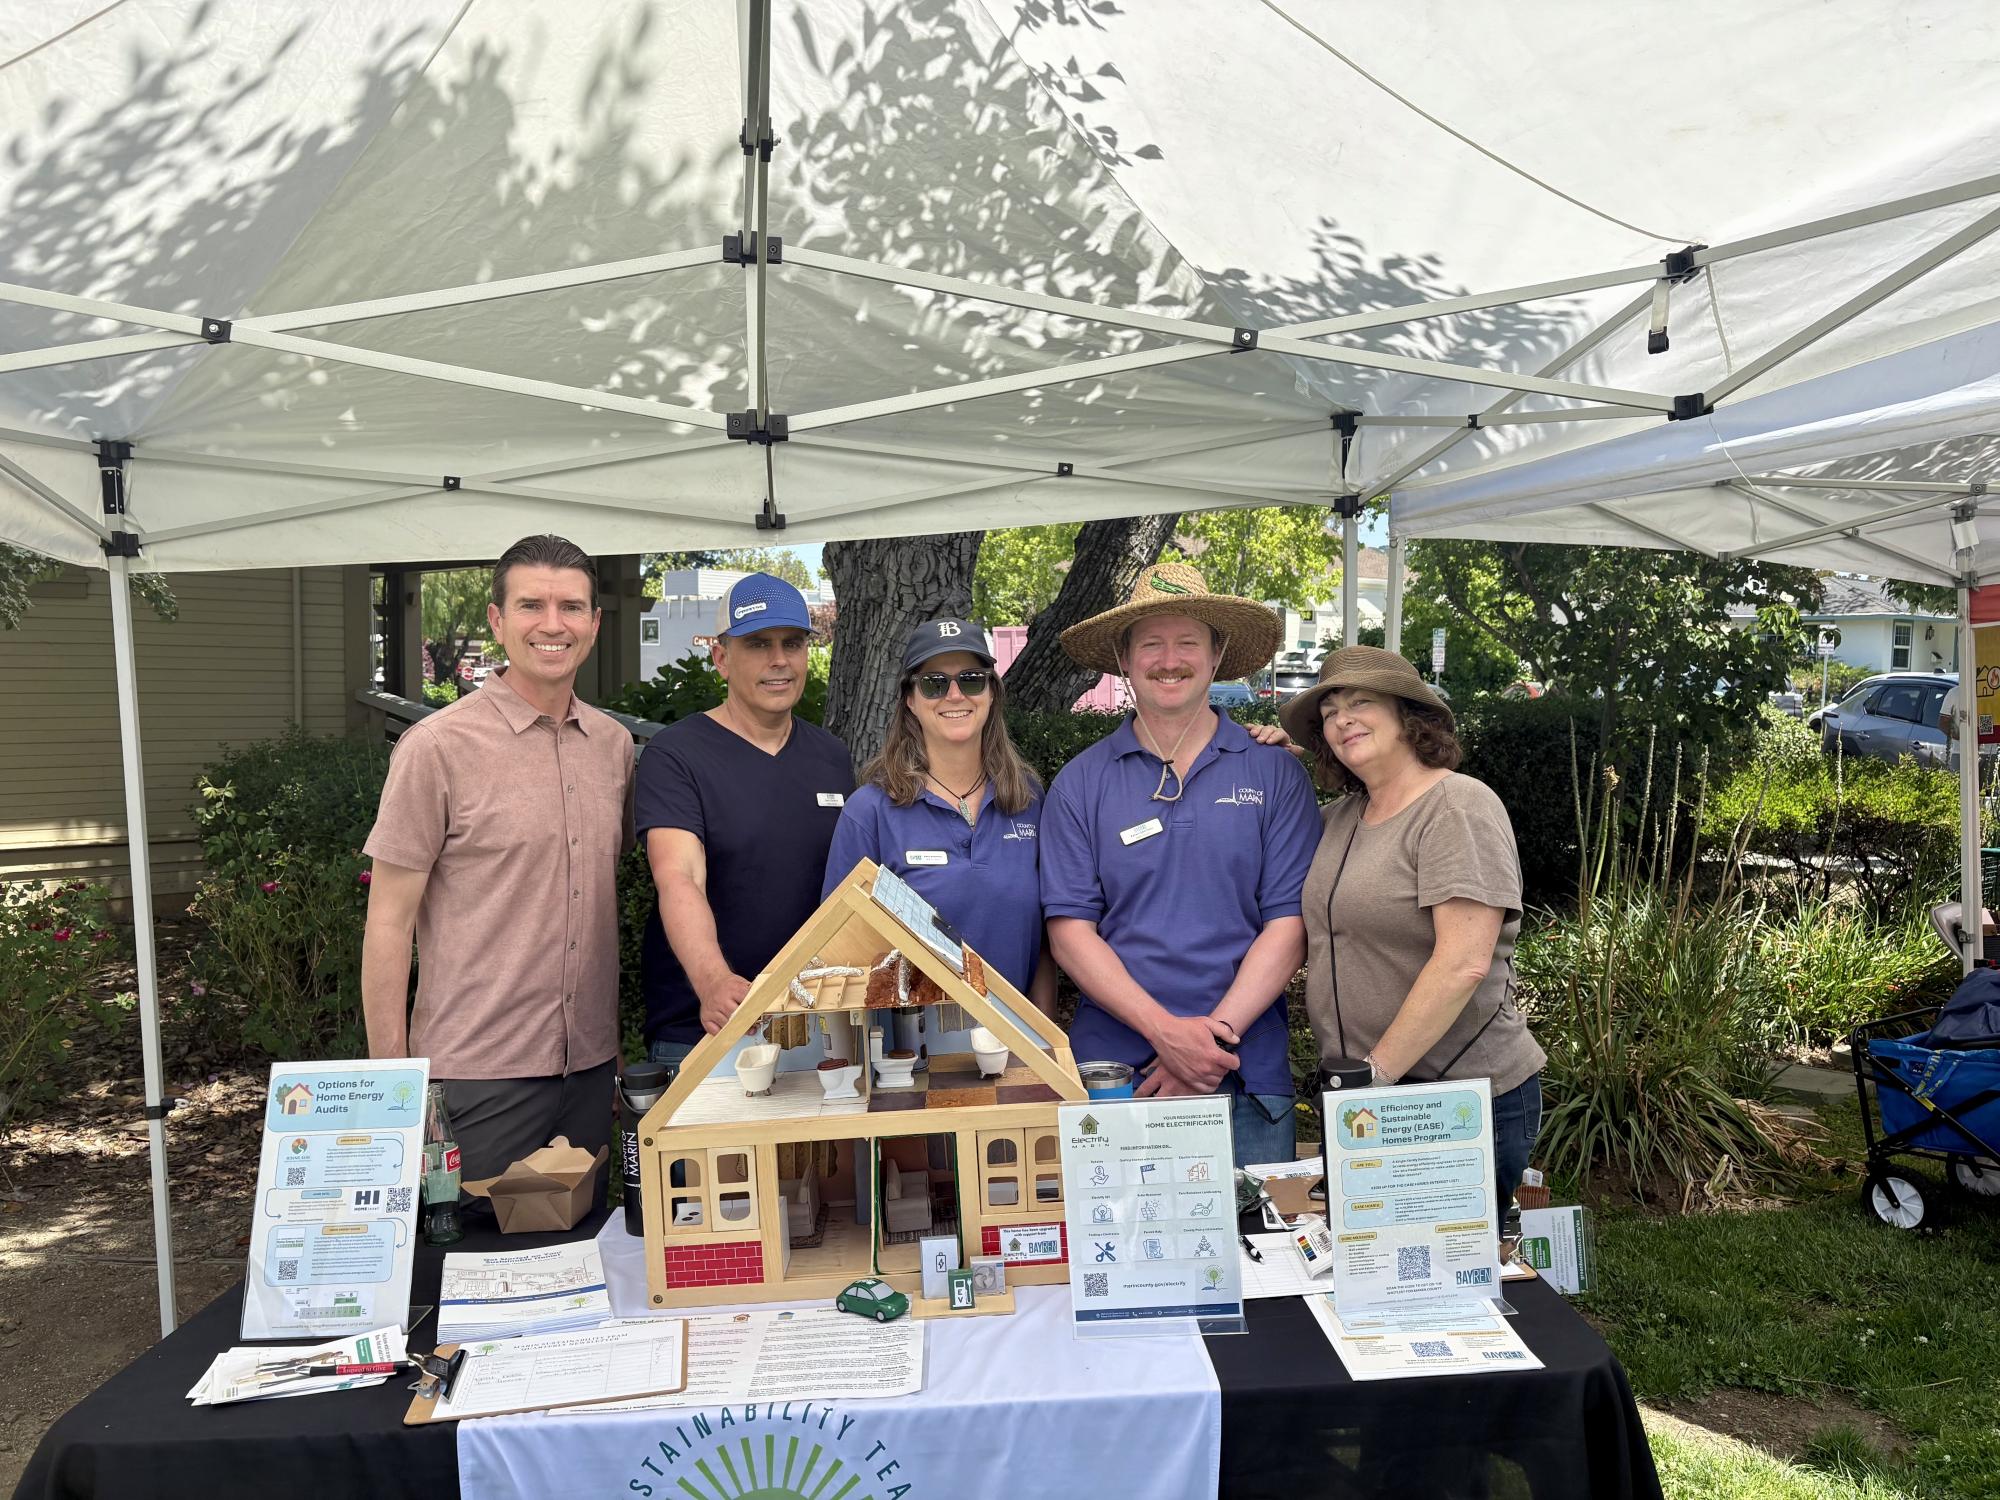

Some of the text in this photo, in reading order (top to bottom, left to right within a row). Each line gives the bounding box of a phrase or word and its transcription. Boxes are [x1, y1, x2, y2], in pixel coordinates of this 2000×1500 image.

[937, 621, 961, 638] B
[317, 1079, 375, 1091] Options for
[316, 1092, 384, 1102] Home Energy
[315, 1105, 348, 1114] Audits
[1380, 1101, 1442, 1113] Efficiency and
[1145, 1119, 1224, 1129] HOME ELECTRIFICATION
[1381, 1113, 1431, 1123] Sustainable
[1381, 1121, 1444, 1134] Energy (EASE)
[1071, 1136, 1109, 1144] Electrify
[1382, 1133, 1451, 1145] Homes Program
[627, 1132, 639, 1177] MARIN
[355, 1190, 380, 1205] HI
[1456, 1267, 1492, 1285] BAYREN
